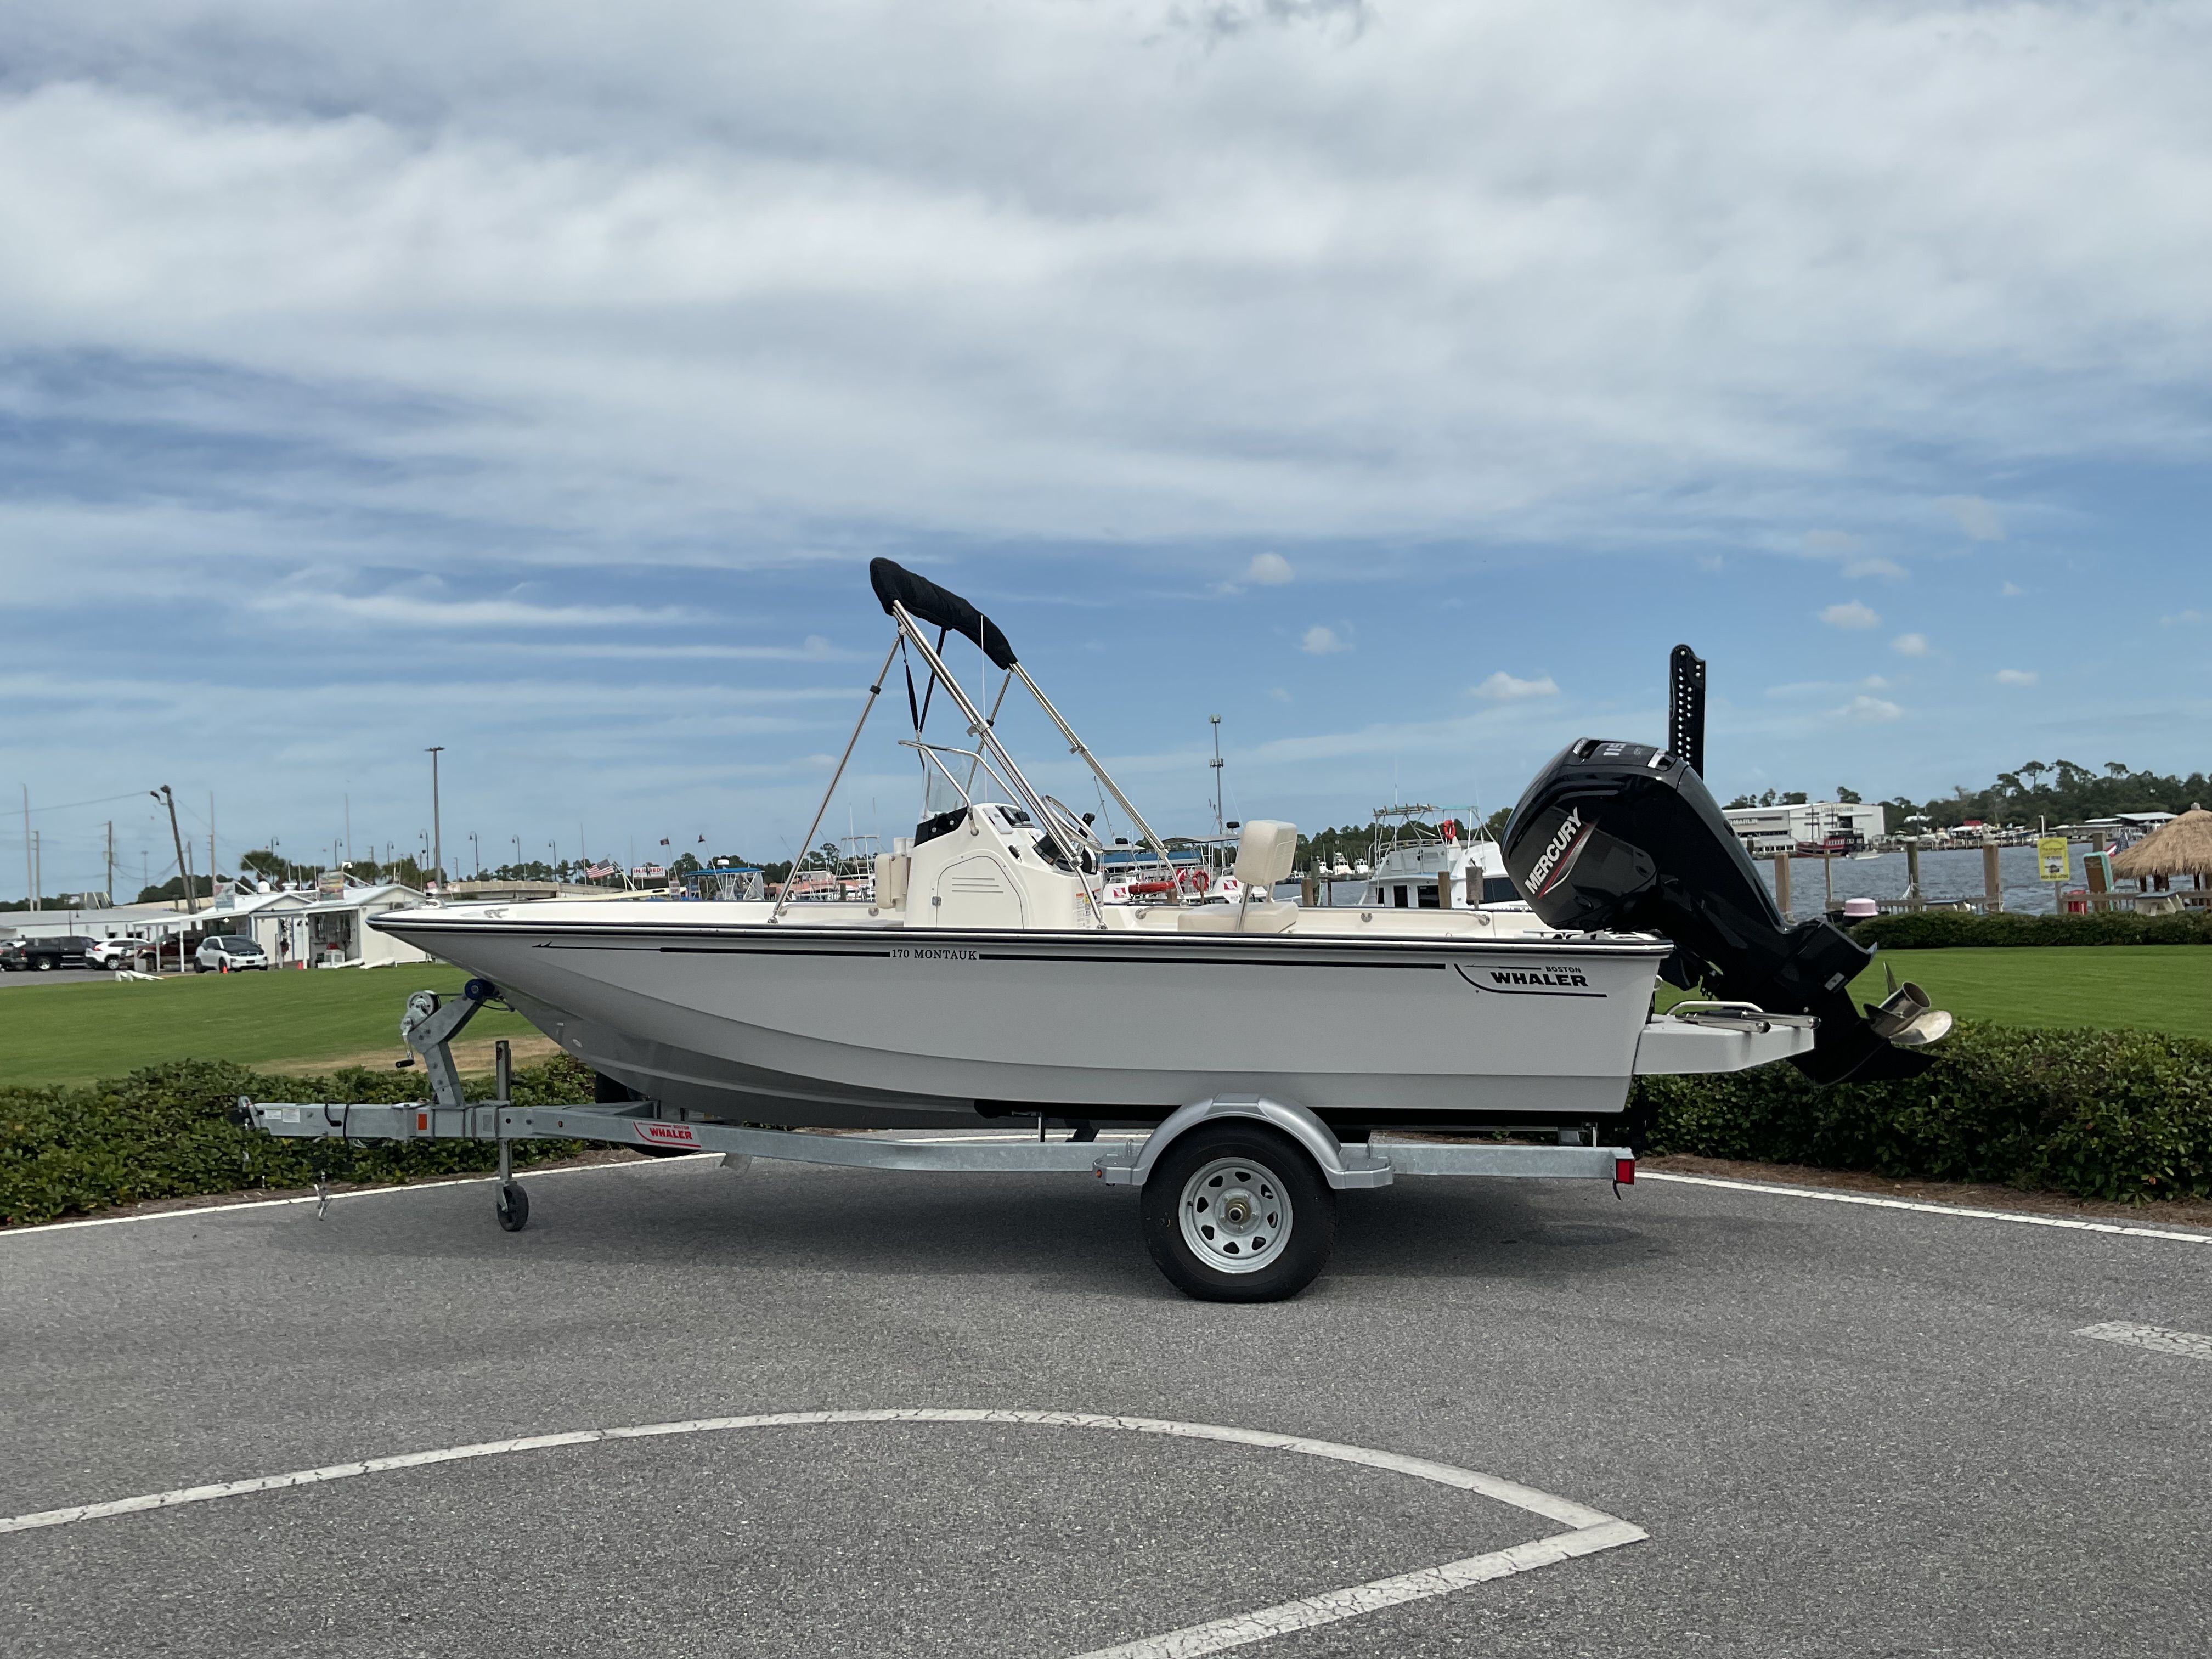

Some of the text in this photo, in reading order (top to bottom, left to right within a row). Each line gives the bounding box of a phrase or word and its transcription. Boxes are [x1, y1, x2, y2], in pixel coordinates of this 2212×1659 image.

[1603, 743, 1627, 756] 115
[1525, 806, 1581, 894] MERCURY
[892, 949, 977, 960] 170 MONTAUK
[1490, 972, 1589, 987] WHALER
[649, 1127, 693, 1140] WHALER
